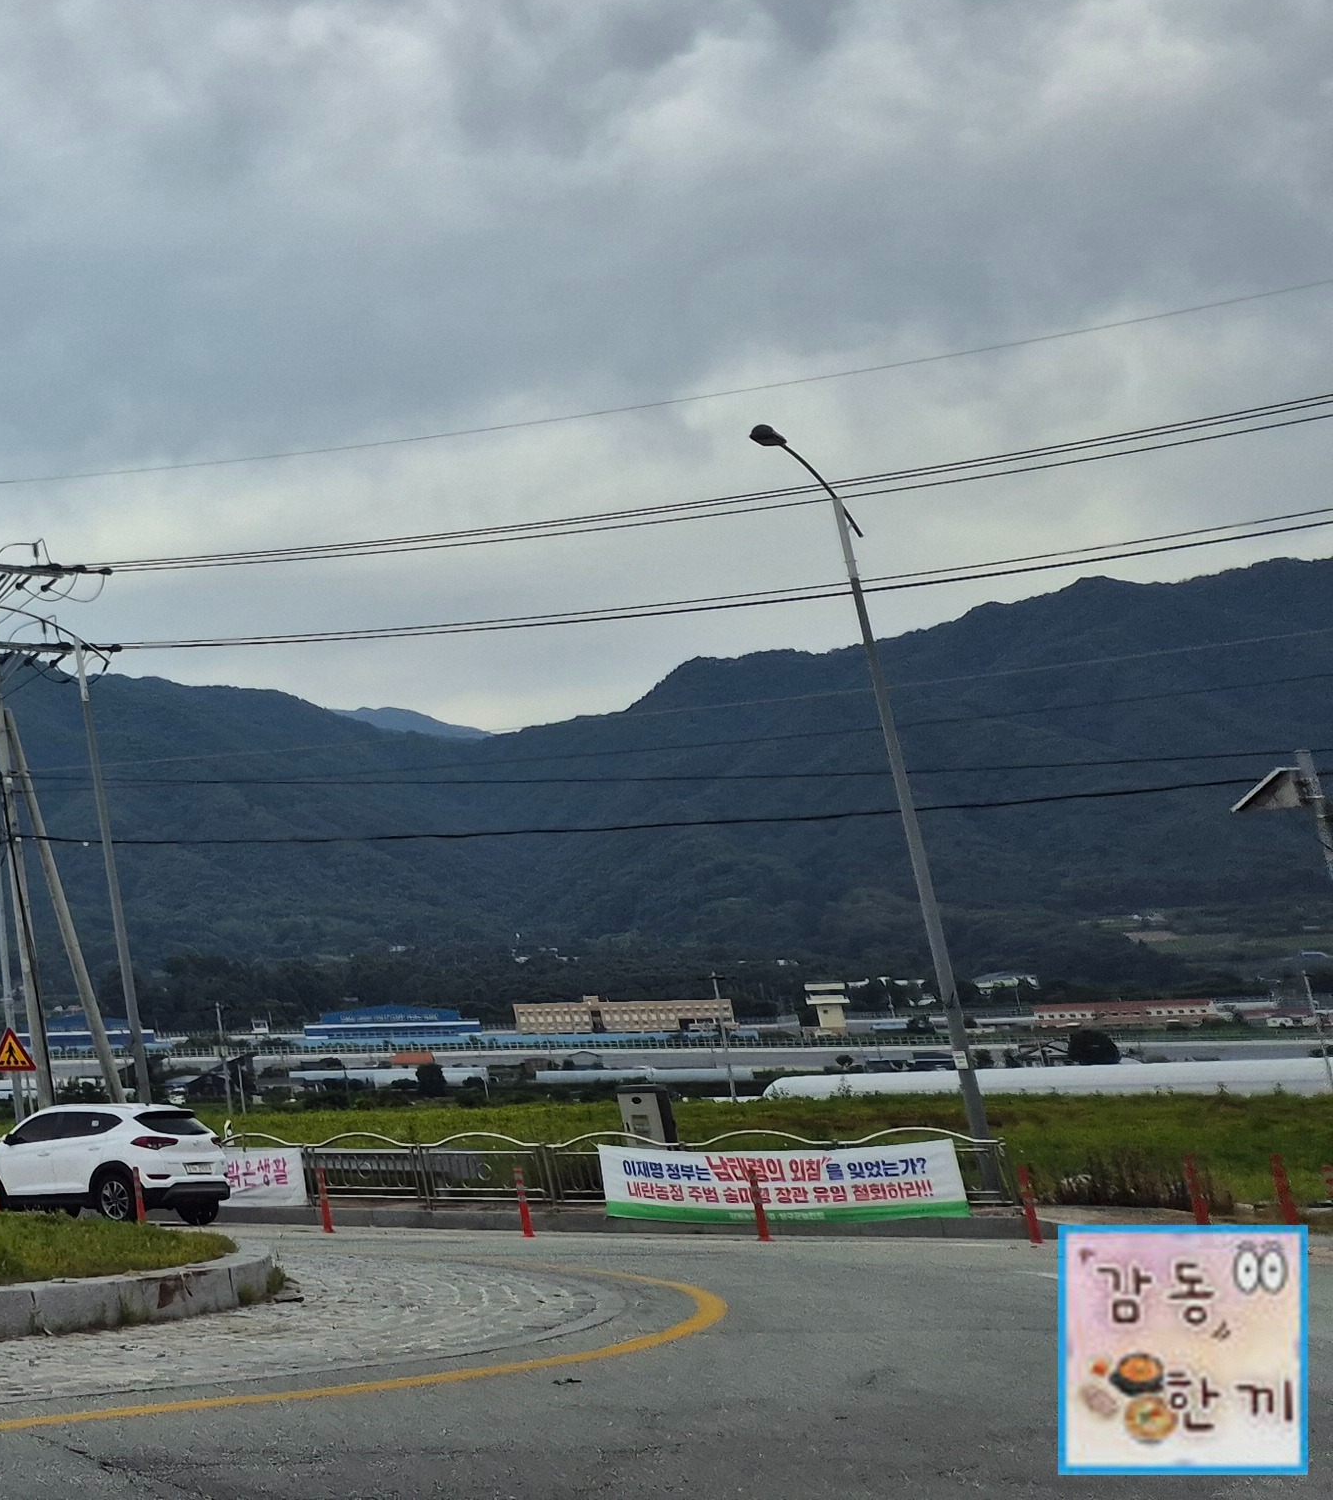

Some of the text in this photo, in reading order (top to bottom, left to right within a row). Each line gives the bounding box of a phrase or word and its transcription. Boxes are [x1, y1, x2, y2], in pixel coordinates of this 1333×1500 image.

[622, 1159, 664, 1179] 이재명
[665, 1161, 711, 1182] 정부는
[705, 1155, 786, 1183] 남태령의
[847, 1157, 927, 1179] 잊었는가?
[626, 1181, 684, 1202] 내란농정
[687, 1185, 720, 1204] 주범
[774, 1186, 810, 1204] 장관
[812, 1185, 848, 1204] 유임
[850, 1179, 934, 1202] 철회하라!!
